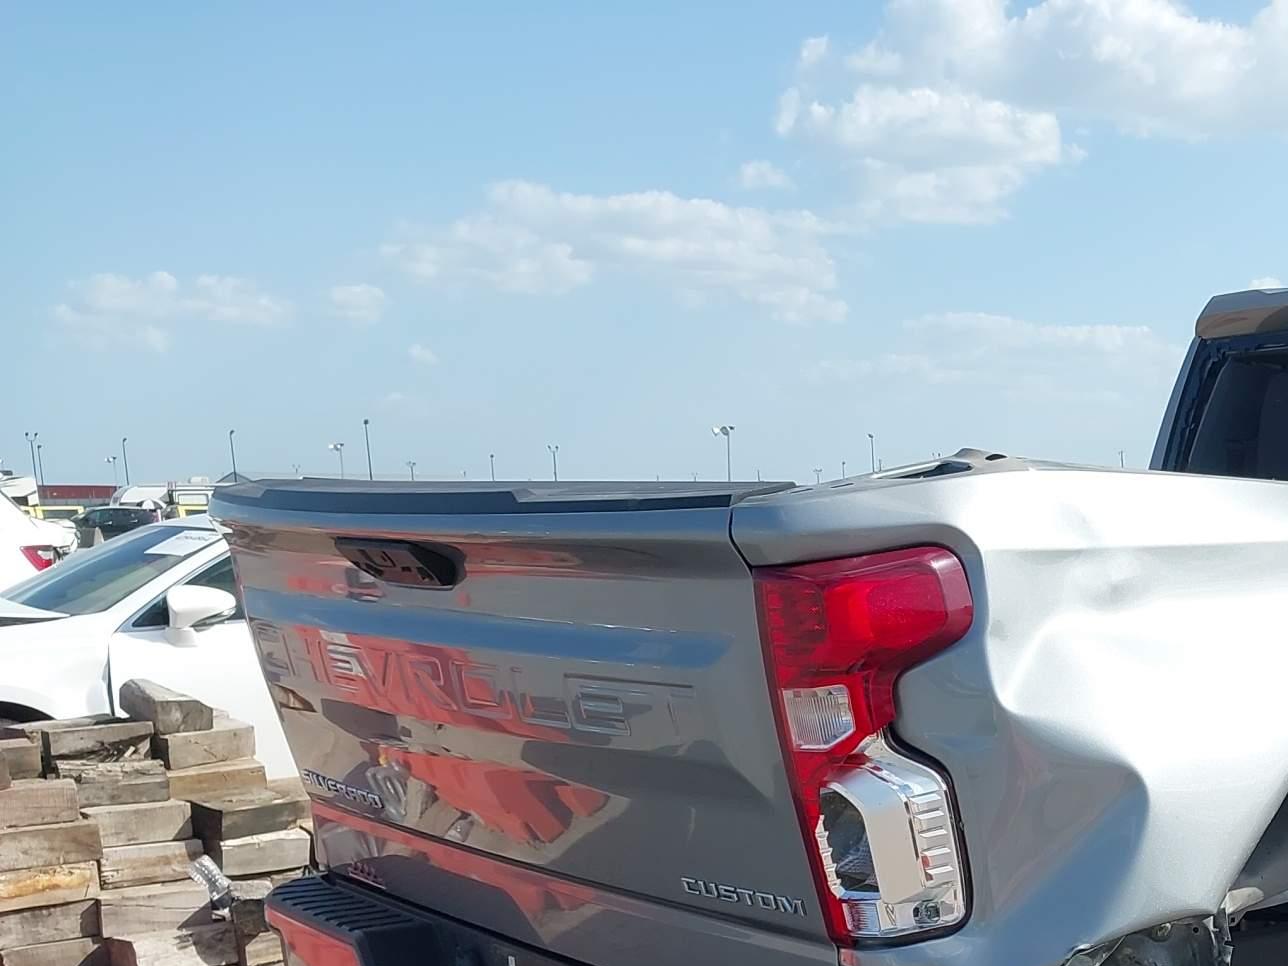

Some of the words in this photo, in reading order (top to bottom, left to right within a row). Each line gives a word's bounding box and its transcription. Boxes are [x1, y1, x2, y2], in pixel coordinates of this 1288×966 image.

[253, 622, 694, 737] CHEVROLET
[302, 769, 384, 809] SILVERADO
[681, 877, 807, 917] CUSTOM
